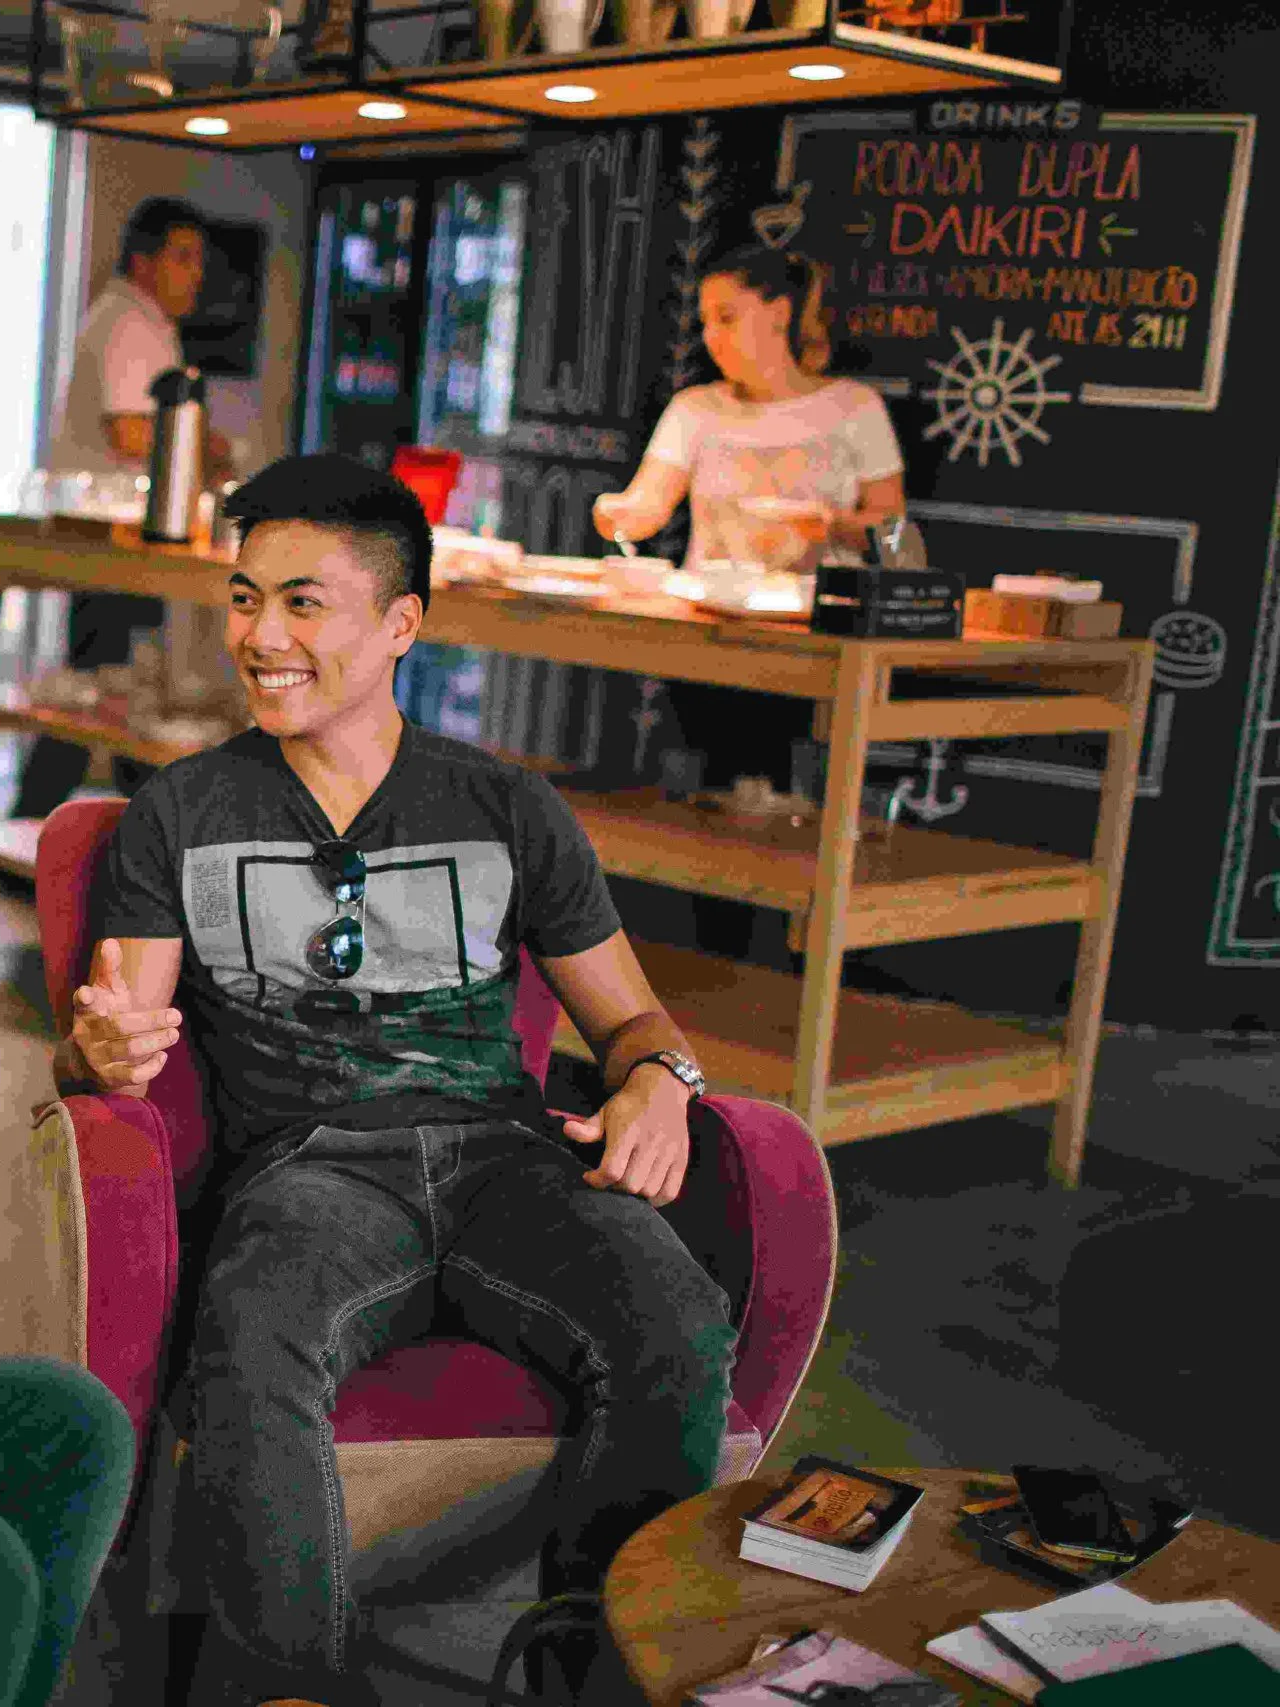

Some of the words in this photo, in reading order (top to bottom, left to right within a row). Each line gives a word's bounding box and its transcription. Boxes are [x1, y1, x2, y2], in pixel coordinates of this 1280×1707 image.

[930, 100, 1081, 129] DRINKS
[1018, 141, 1141, 200] DUPLA
[889, 202, 1088, 260] DAIKIRI
